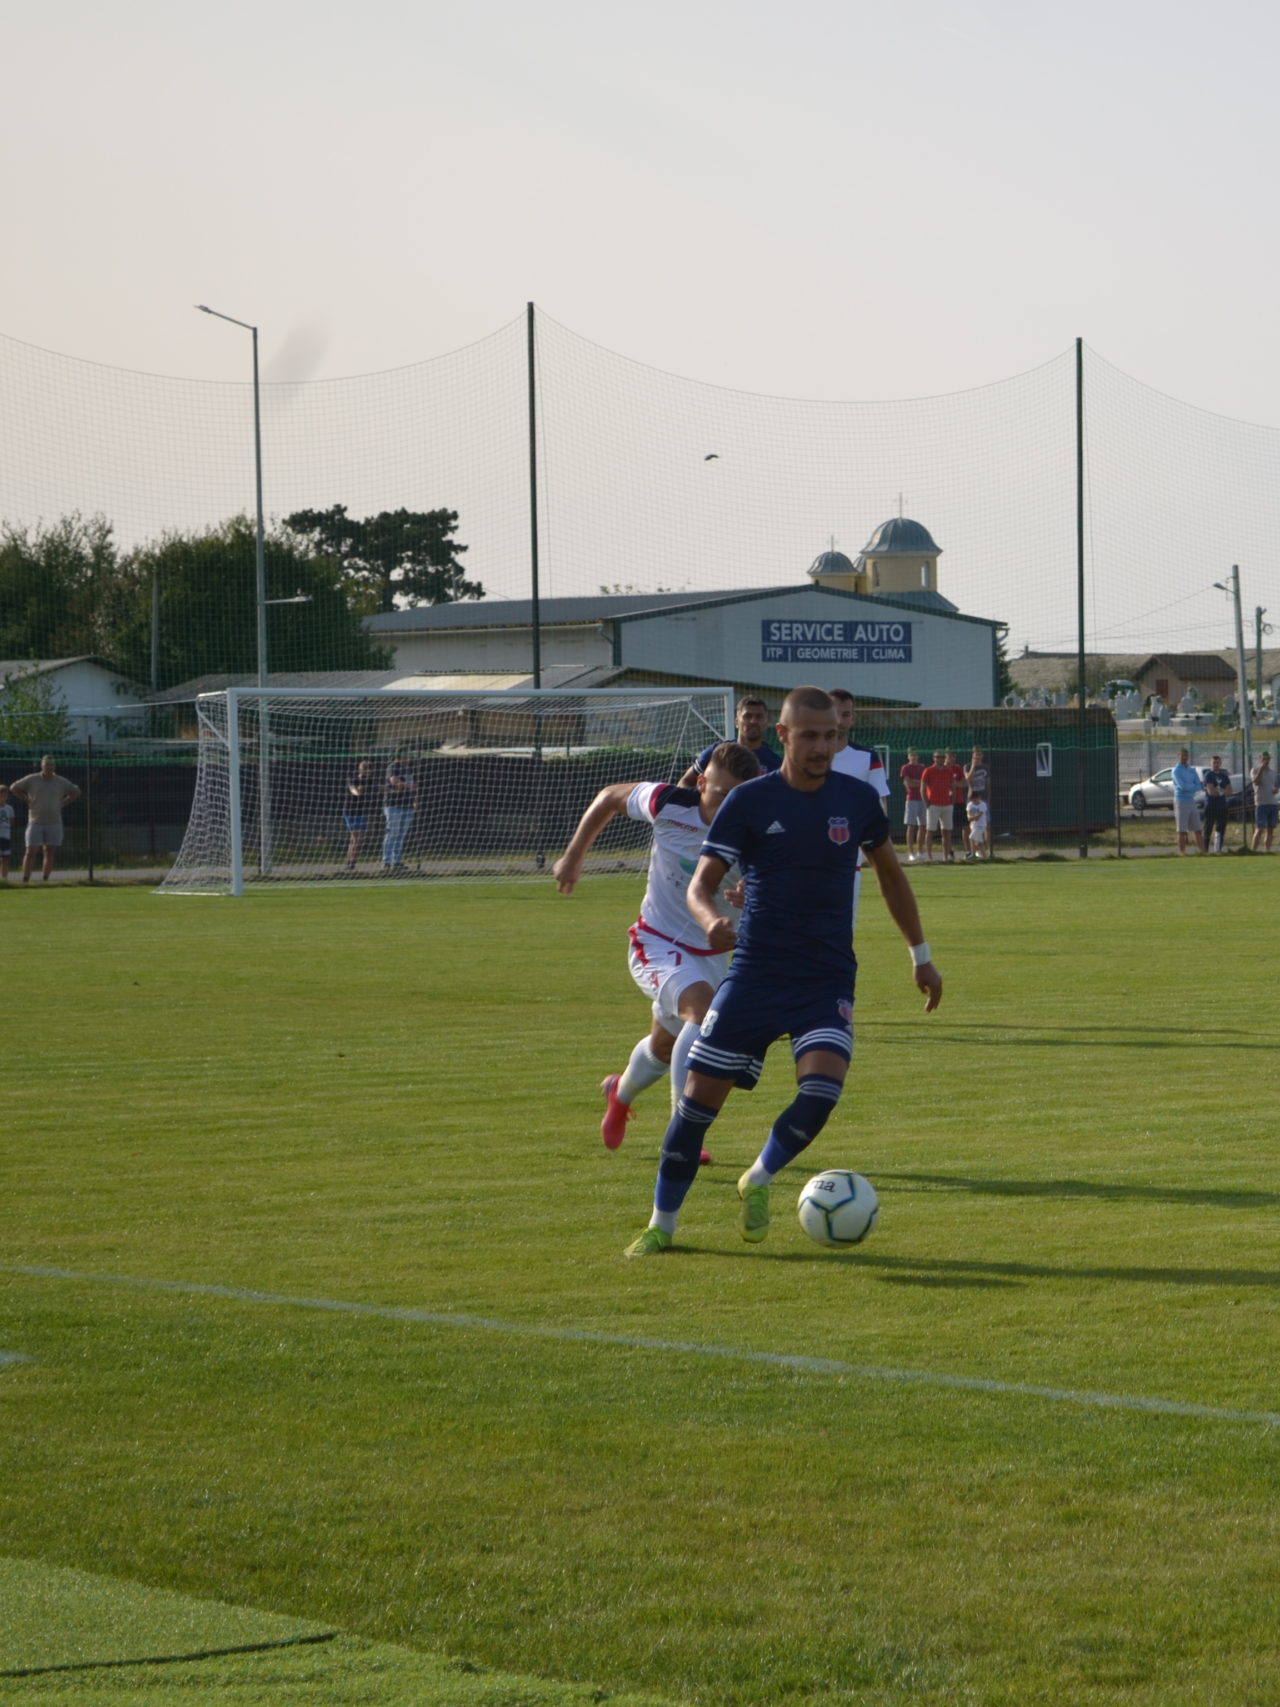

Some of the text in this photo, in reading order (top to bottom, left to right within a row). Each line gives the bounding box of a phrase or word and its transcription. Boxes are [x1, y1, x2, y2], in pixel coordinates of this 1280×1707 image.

[770, 623, 904, 642] SERVICE AUTO
[766, 647, 906, 660] ITP GEOMETRIE CLIMA
[667, 950, 683, 967] 7
